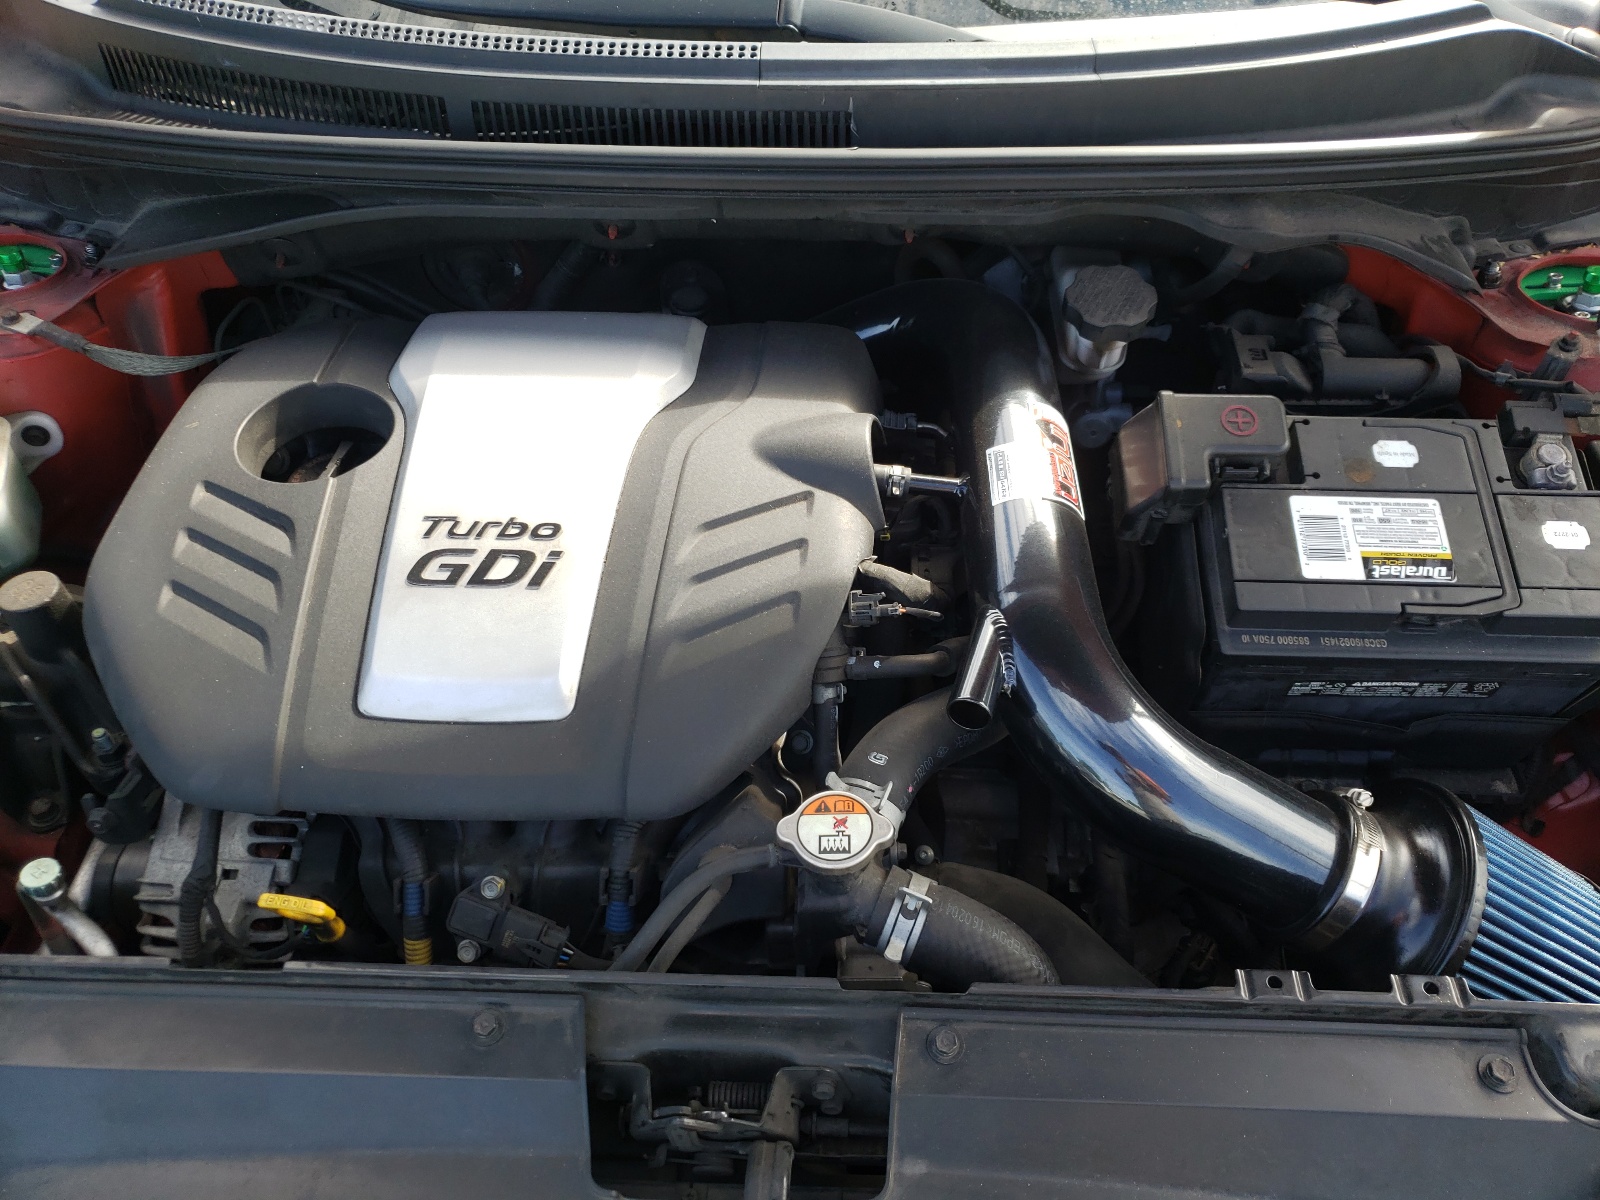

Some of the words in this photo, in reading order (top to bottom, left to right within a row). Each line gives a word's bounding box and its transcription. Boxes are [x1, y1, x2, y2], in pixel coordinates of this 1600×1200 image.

[422, 515, 564, 541] Turbo
[405, 548, 565, 590] GDi
[1372, 564, 1452, 580] Duralast
[267, 895, 289, 906] ENG
[290, 899, 307, 910] OIL
